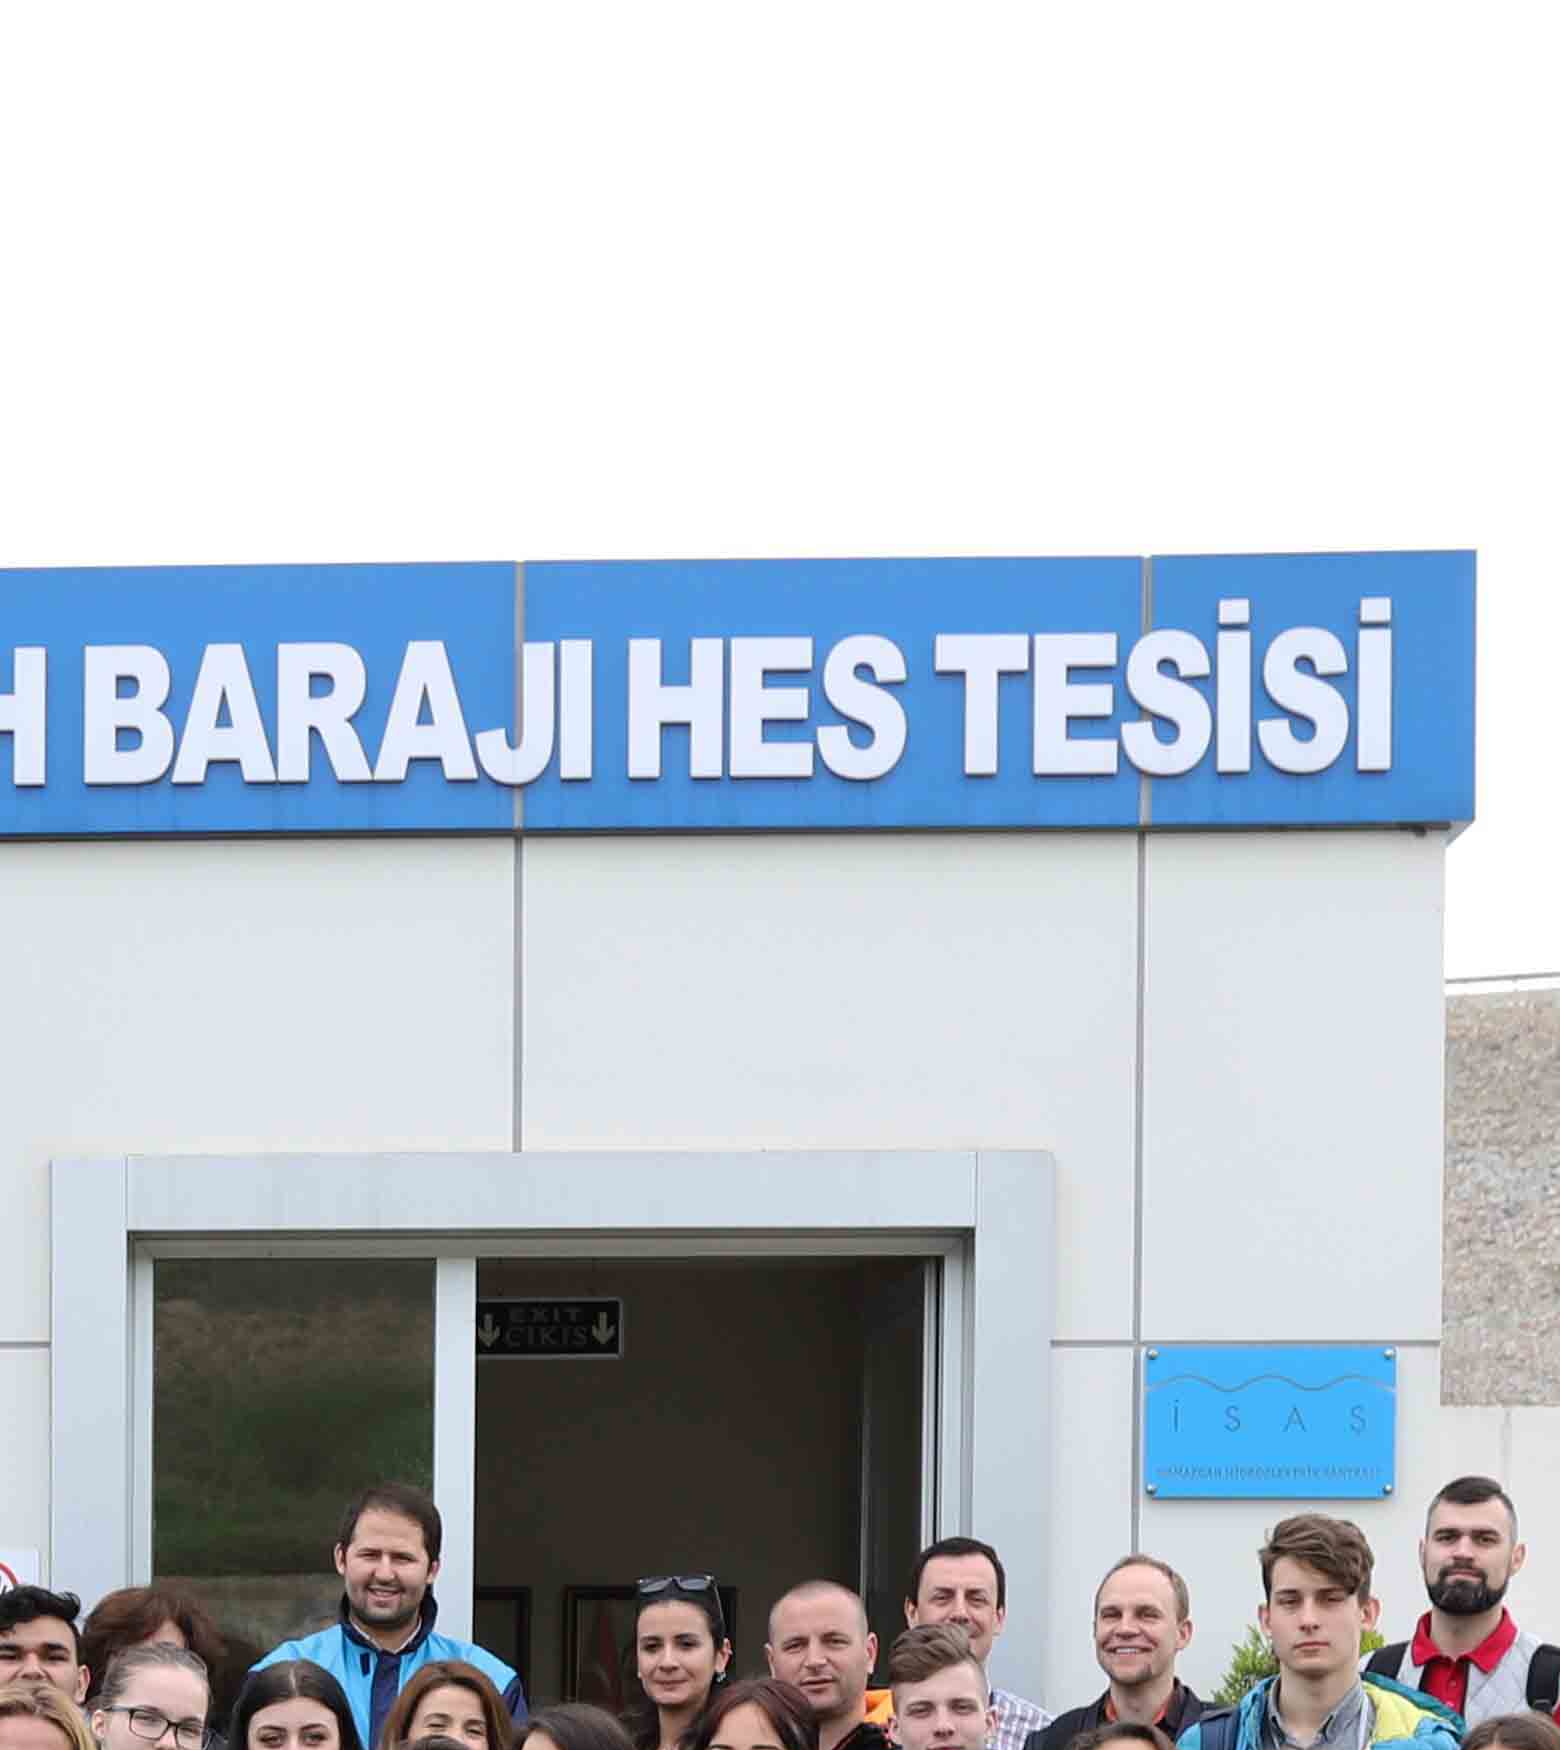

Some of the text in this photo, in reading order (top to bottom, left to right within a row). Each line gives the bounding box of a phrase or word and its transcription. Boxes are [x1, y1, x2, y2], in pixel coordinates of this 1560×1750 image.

[84, 638, 593, 785] BARAJI
[628, 635, 907, 781] HES
[935, 597, 1393, 775] TESİSİ
[508, 1306, 583, 1323] EXIT
